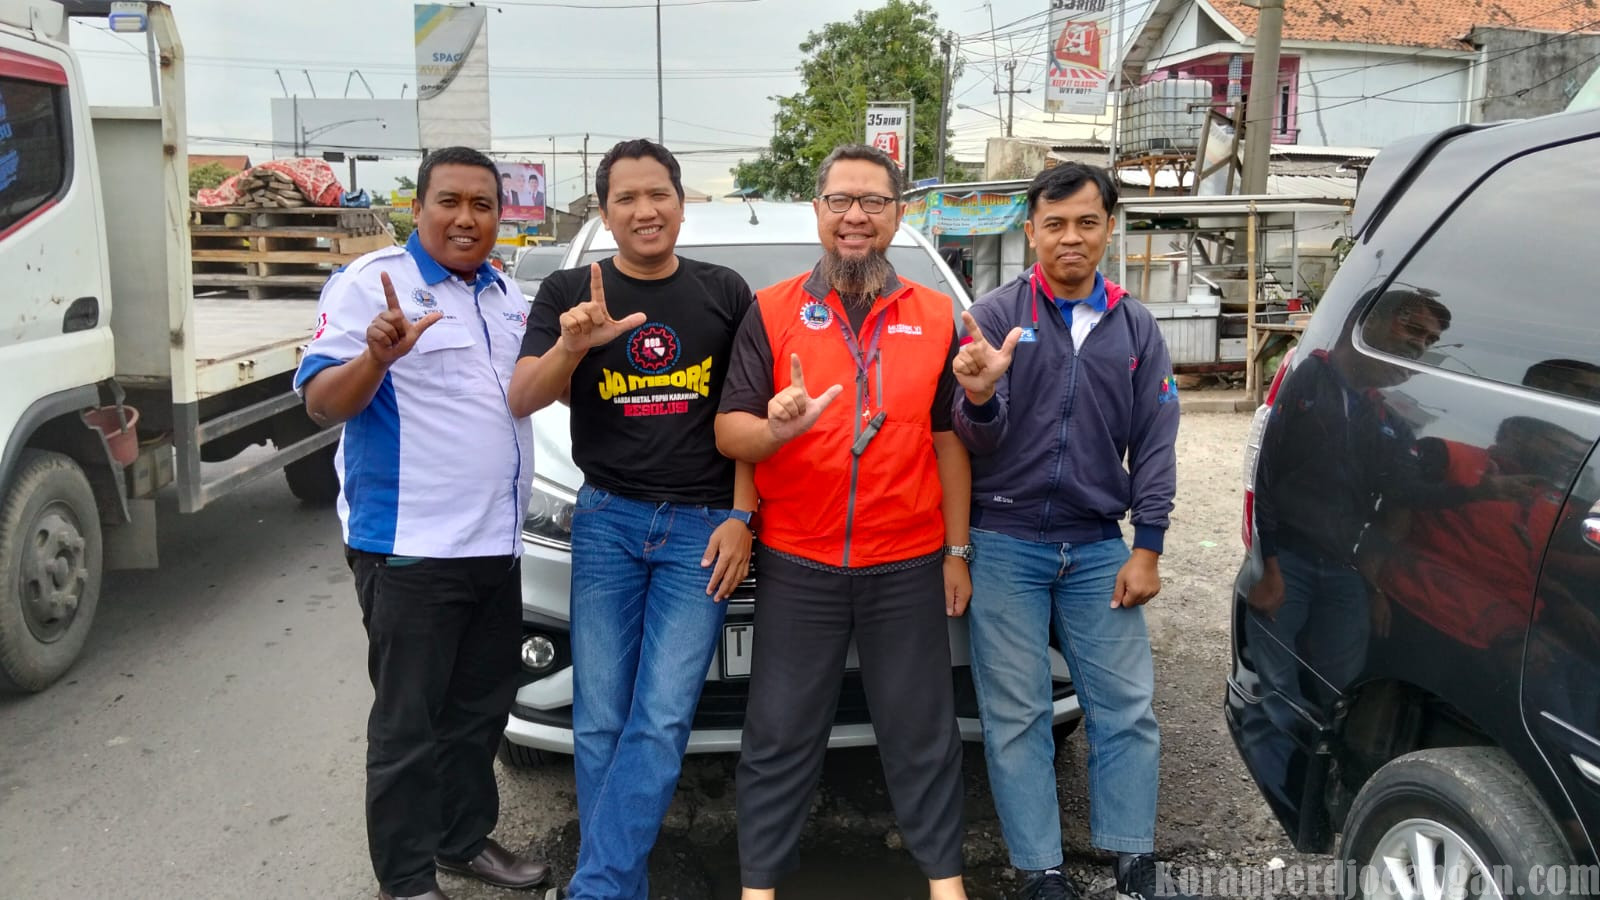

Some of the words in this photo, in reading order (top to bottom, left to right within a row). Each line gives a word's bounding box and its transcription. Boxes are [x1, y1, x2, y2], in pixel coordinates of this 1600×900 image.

[599, 356, 713, 400] JAMBORE
[624, 401, 688, 417] RESOLUSI
[730, 627, 747, 657] T
